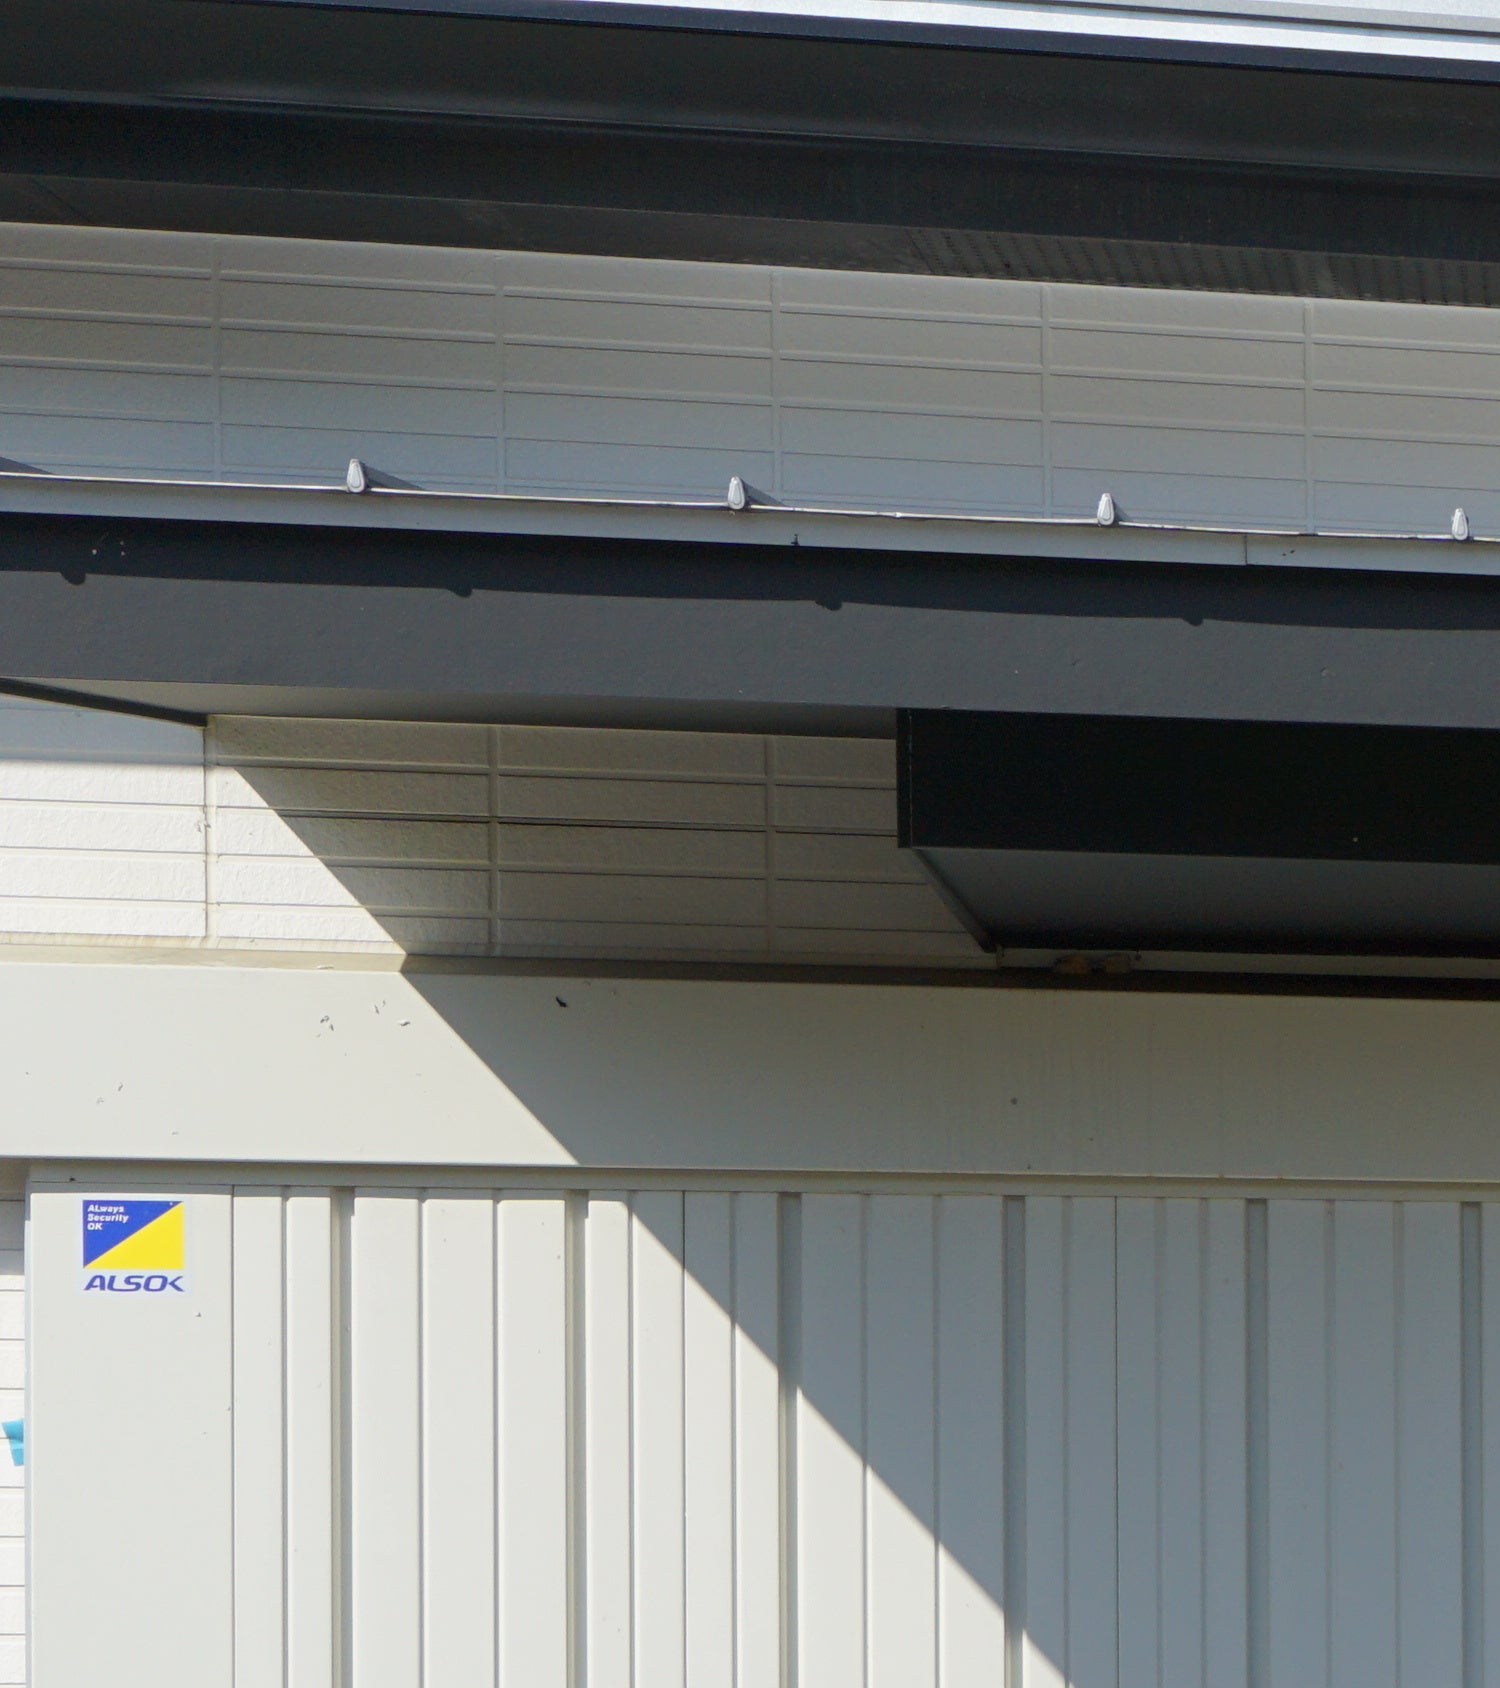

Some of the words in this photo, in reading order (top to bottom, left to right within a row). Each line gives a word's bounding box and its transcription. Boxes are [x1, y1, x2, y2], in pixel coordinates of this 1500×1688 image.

[87, 1213, 129, 1224] Security
[87, 1222, 103, 1231] OK
[84, 1274, 185, 1292] ALSOK
